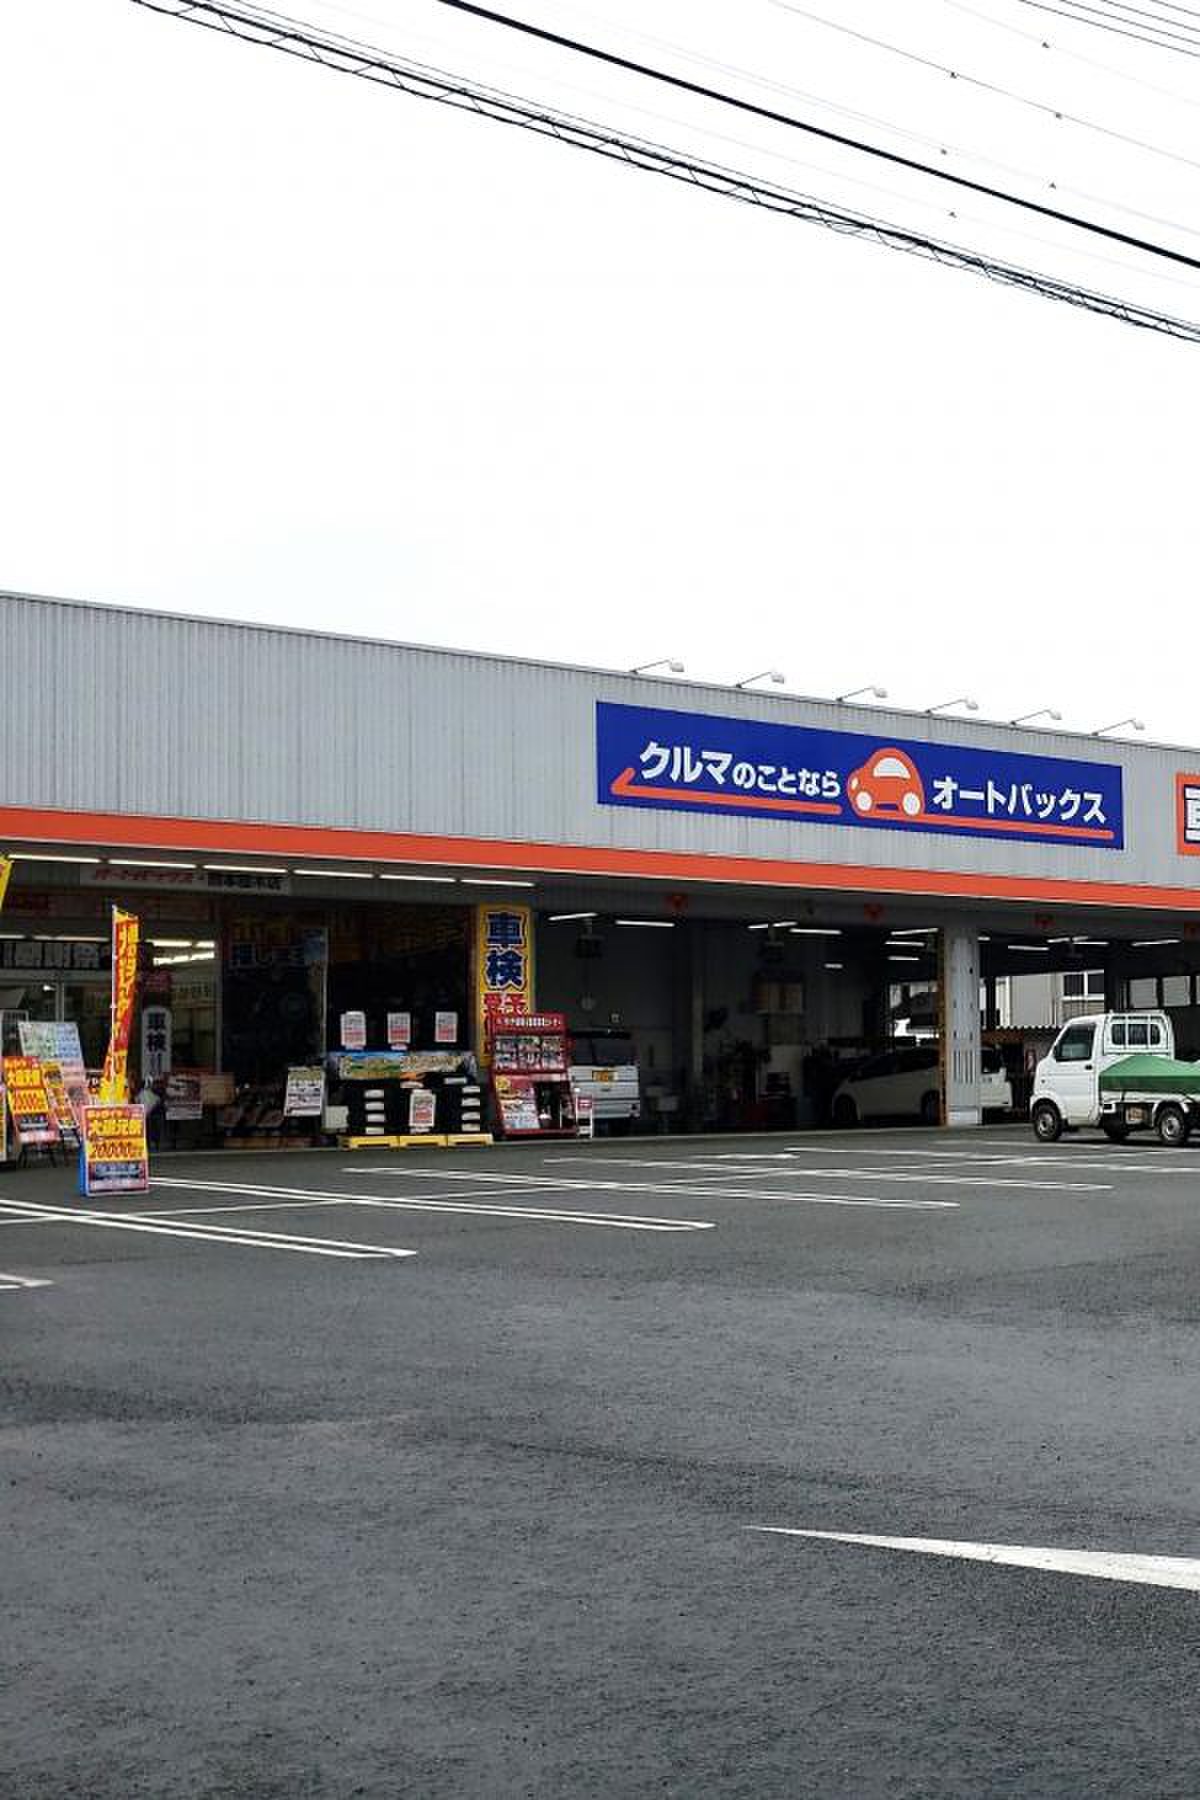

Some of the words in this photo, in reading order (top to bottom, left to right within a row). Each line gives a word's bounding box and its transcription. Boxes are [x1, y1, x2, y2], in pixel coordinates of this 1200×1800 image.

[638, 741, 841, 799] クルマのことなら
[932, 776, 1107, 824] オートバックス
[486, 911, 527, 989] 車検
